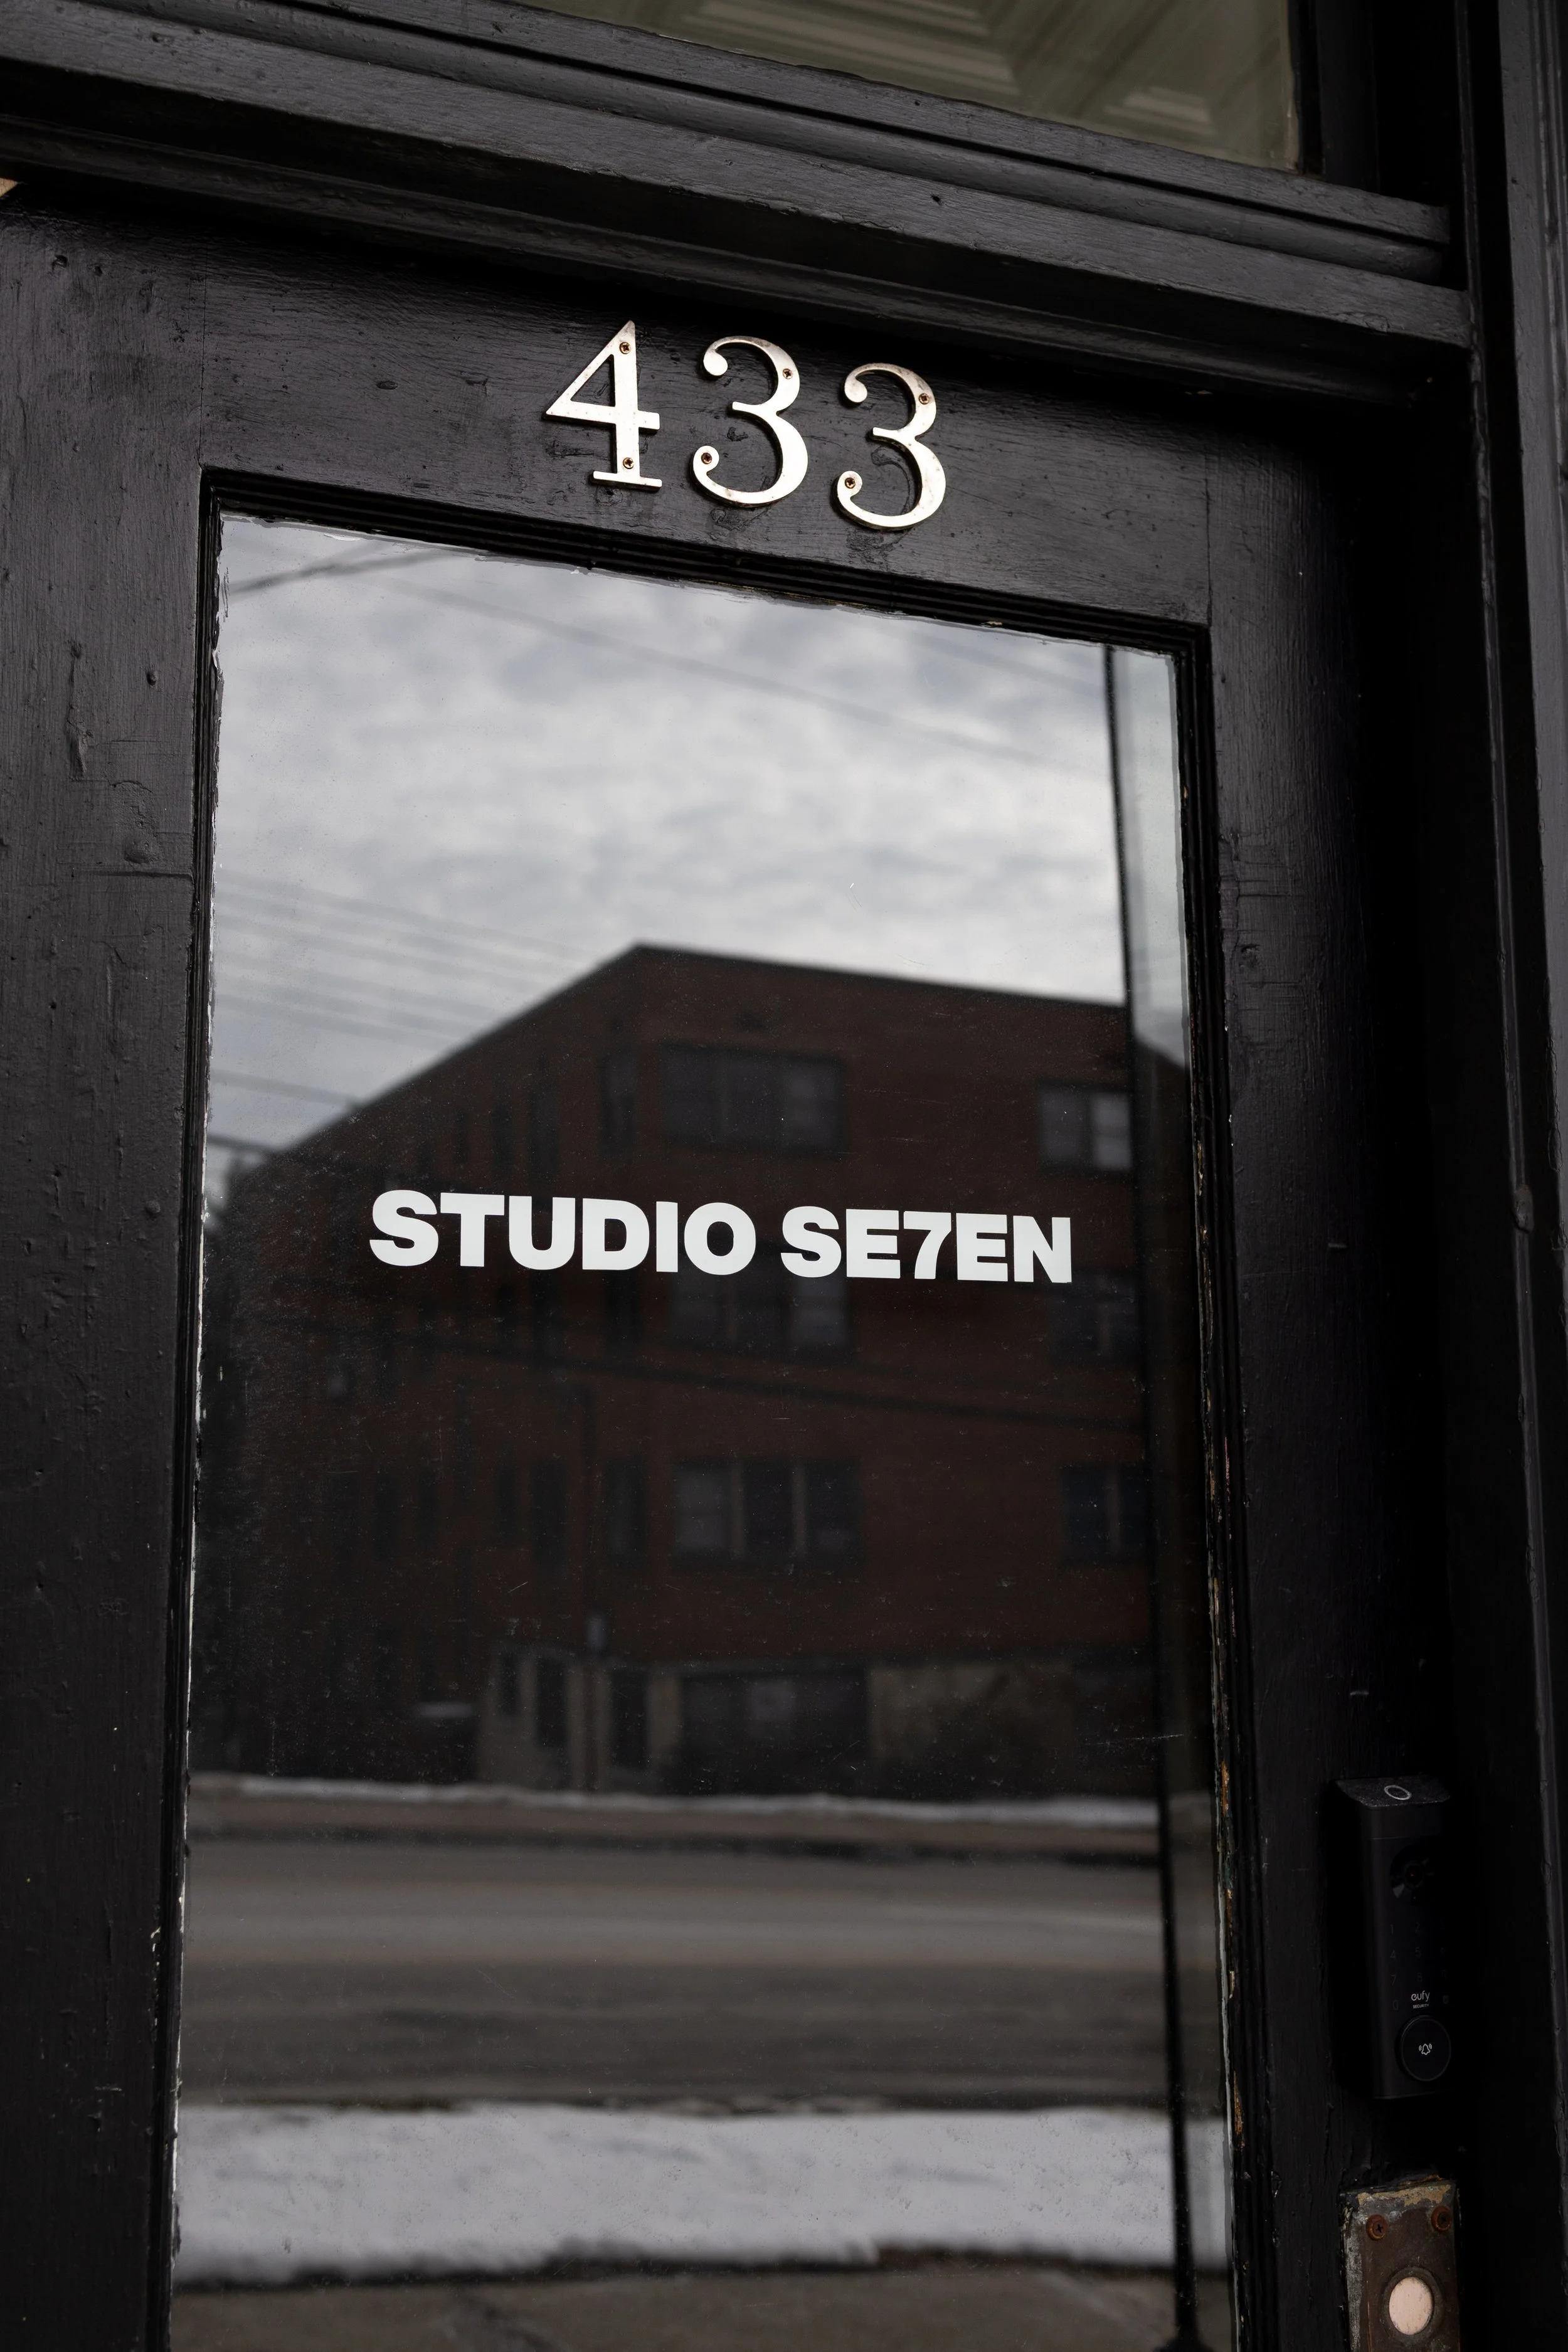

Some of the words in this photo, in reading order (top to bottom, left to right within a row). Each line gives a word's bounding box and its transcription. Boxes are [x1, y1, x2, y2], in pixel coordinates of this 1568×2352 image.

[544, 320, 946, 530] 433
[369, 1189, 756, 1276] STUDIO
[780, 1205, 1072, 1283] SE7EN
[1413, 1921, 1421, 1933] 2
[1389, 1949, 1397, 1959] 4
[1414, 1946, 1422, 1958] 5
[1390, 1974, 1397, 1985] 7
[1416, 1971, 1423, 1983] 8
[1411, 1990, 1430, 2002] eufy
